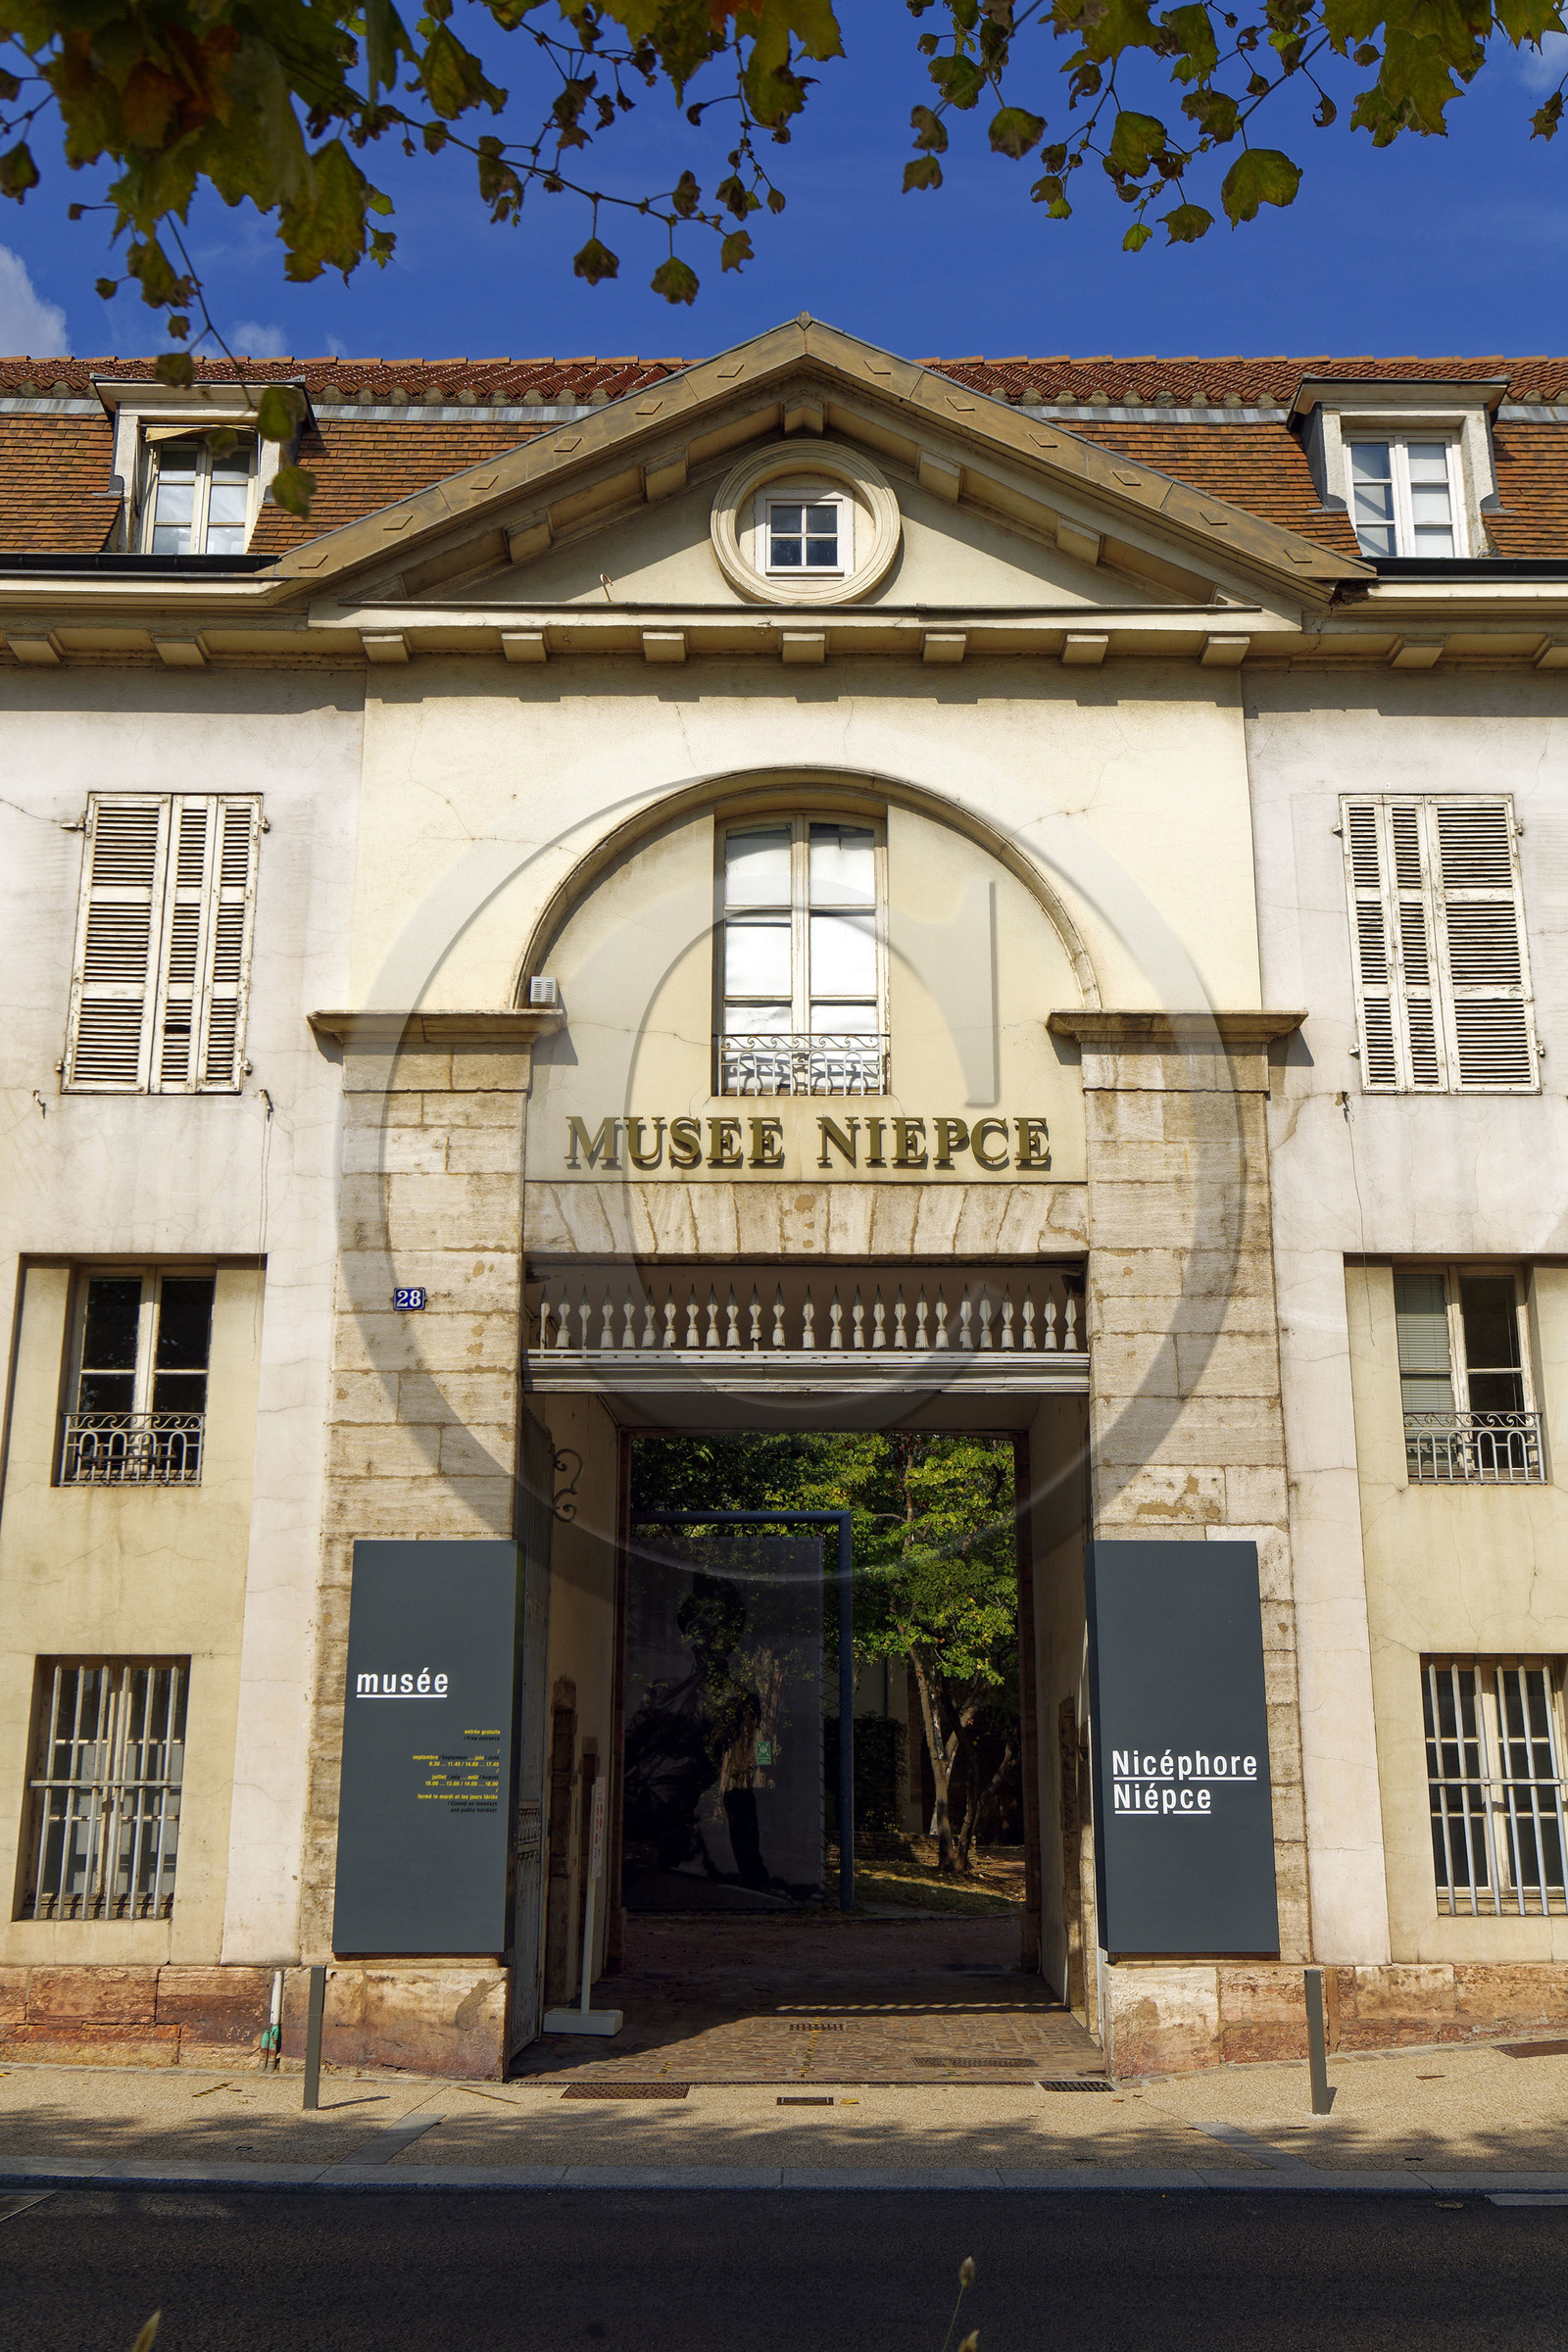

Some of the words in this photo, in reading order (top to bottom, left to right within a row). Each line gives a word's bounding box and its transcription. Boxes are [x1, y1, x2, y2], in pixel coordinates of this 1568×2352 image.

[564, 1115, 783, 1162] MUSEE
[816, 1115, 1052, 1163] NIEPCE
[396, 1290, 421, 1307] 28
[356, 1667, 449, 1694] musée
[1111, 1748, 1258, 1781] Nicéphore
[1113, 1783, 1211, 1814] Niépce
